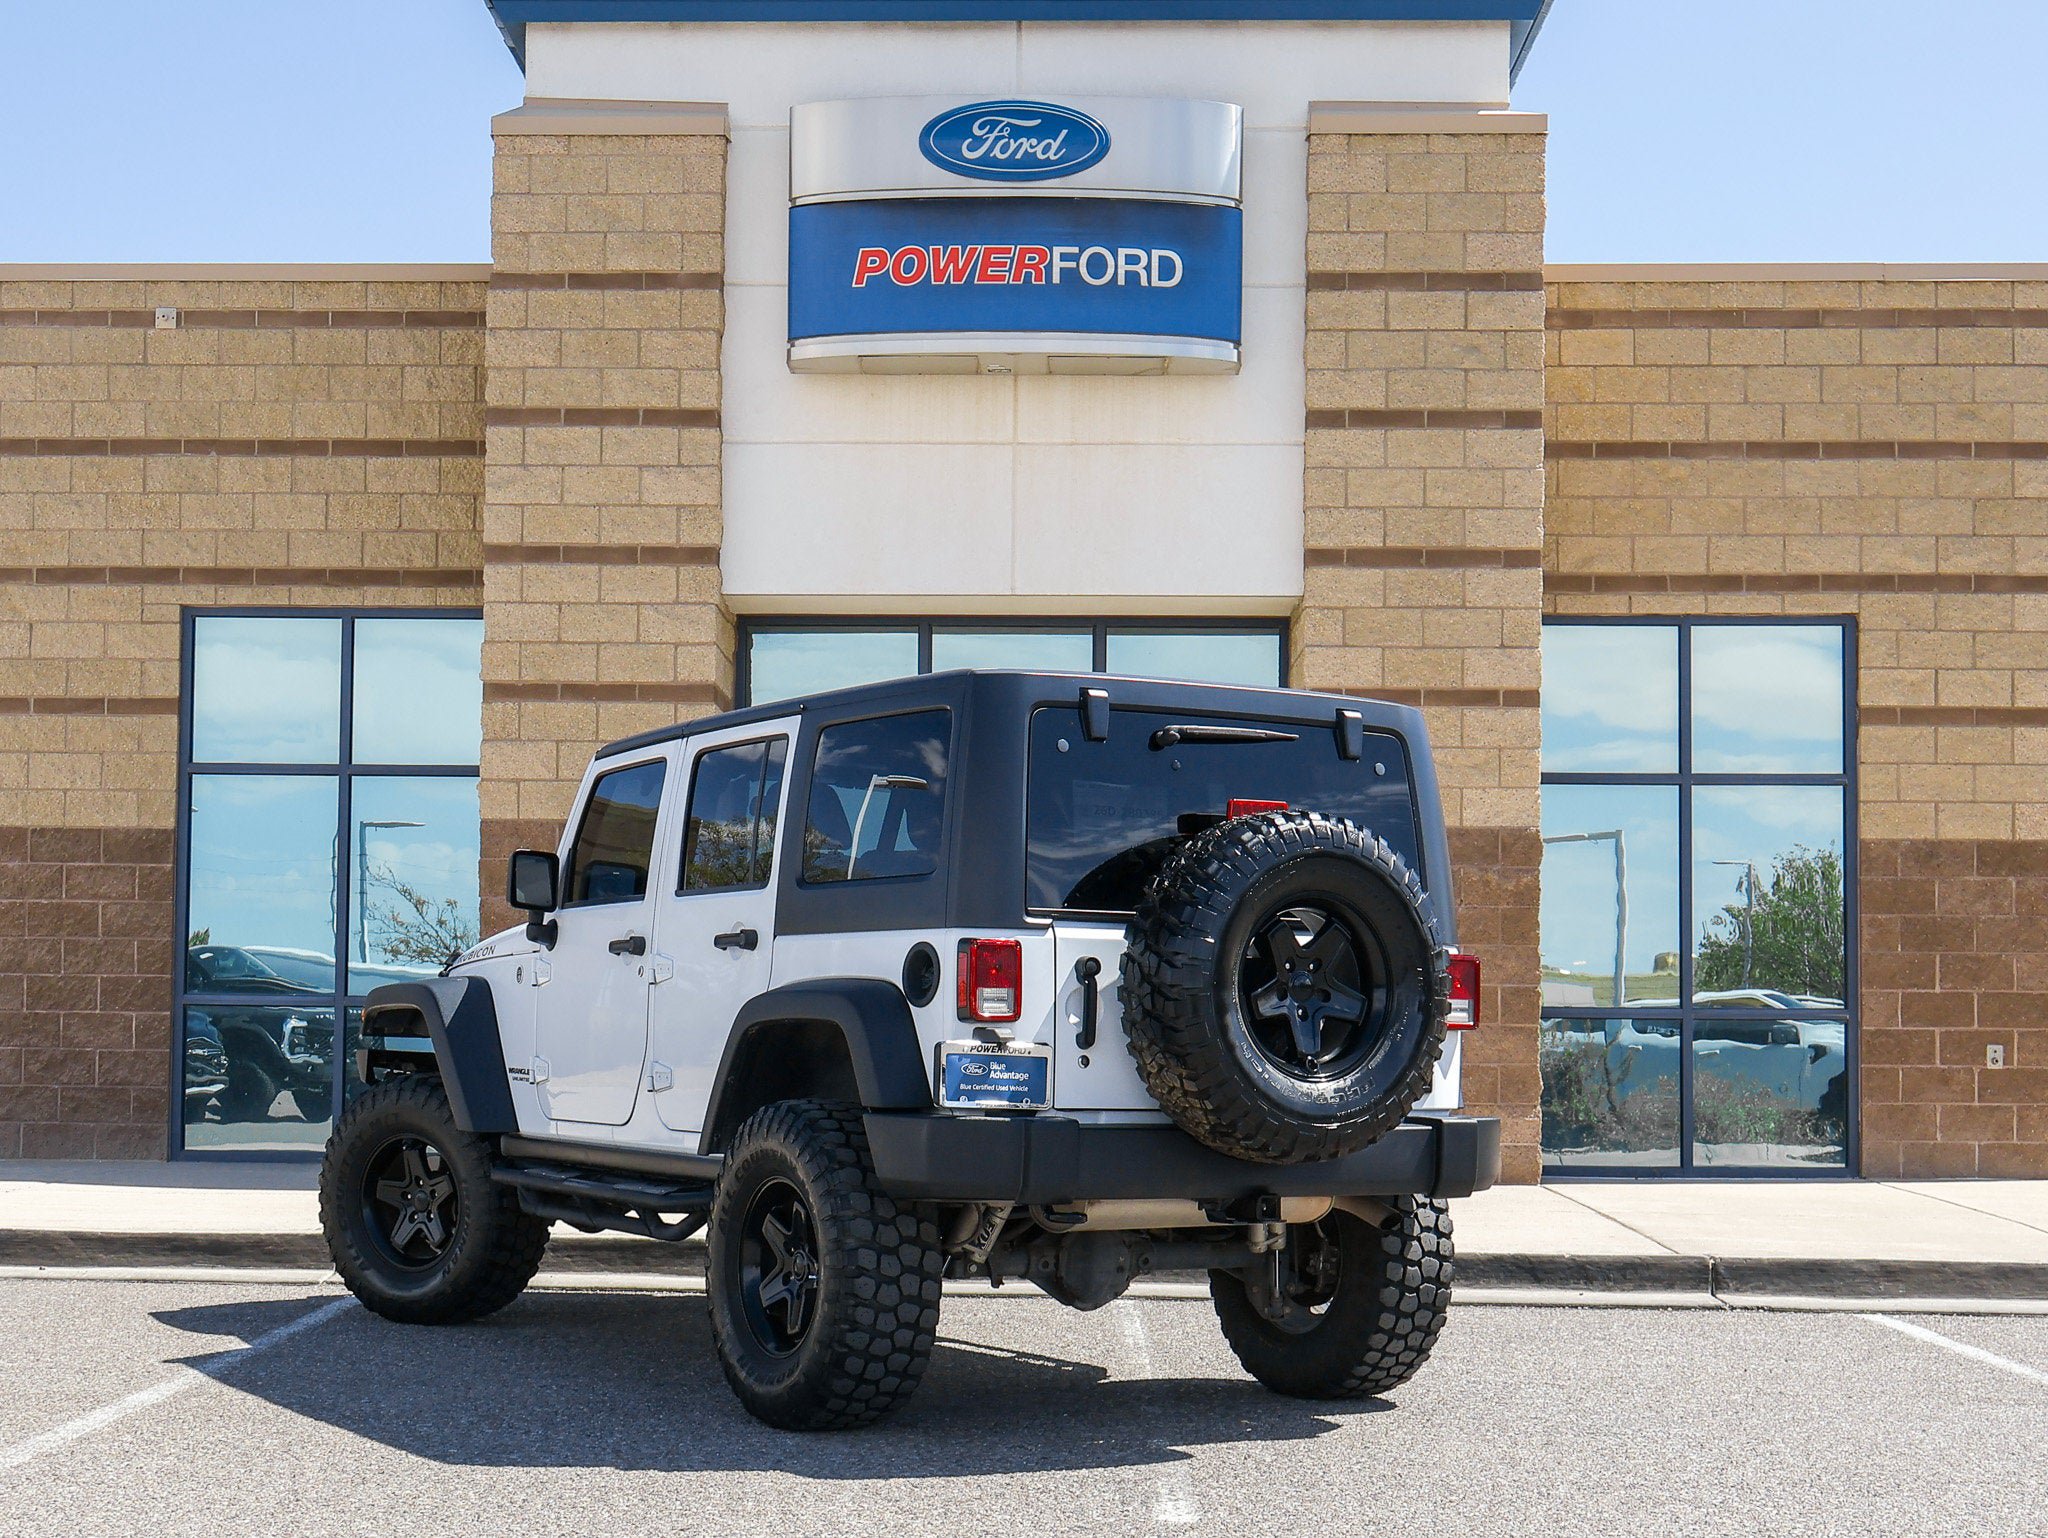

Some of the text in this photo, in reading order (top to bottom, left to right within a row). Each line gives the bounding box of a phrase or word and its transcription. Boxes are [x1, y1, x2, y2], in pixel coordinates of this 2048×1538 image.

[961, 116, 1068, 161] Ford
[990, 1061, 1007, 1071] Blue
[990, 1070, 1029, 1082] Advantage
[972, 1083, 995, 1091] Certified
[996, 1084, 1008, 1092] Used
